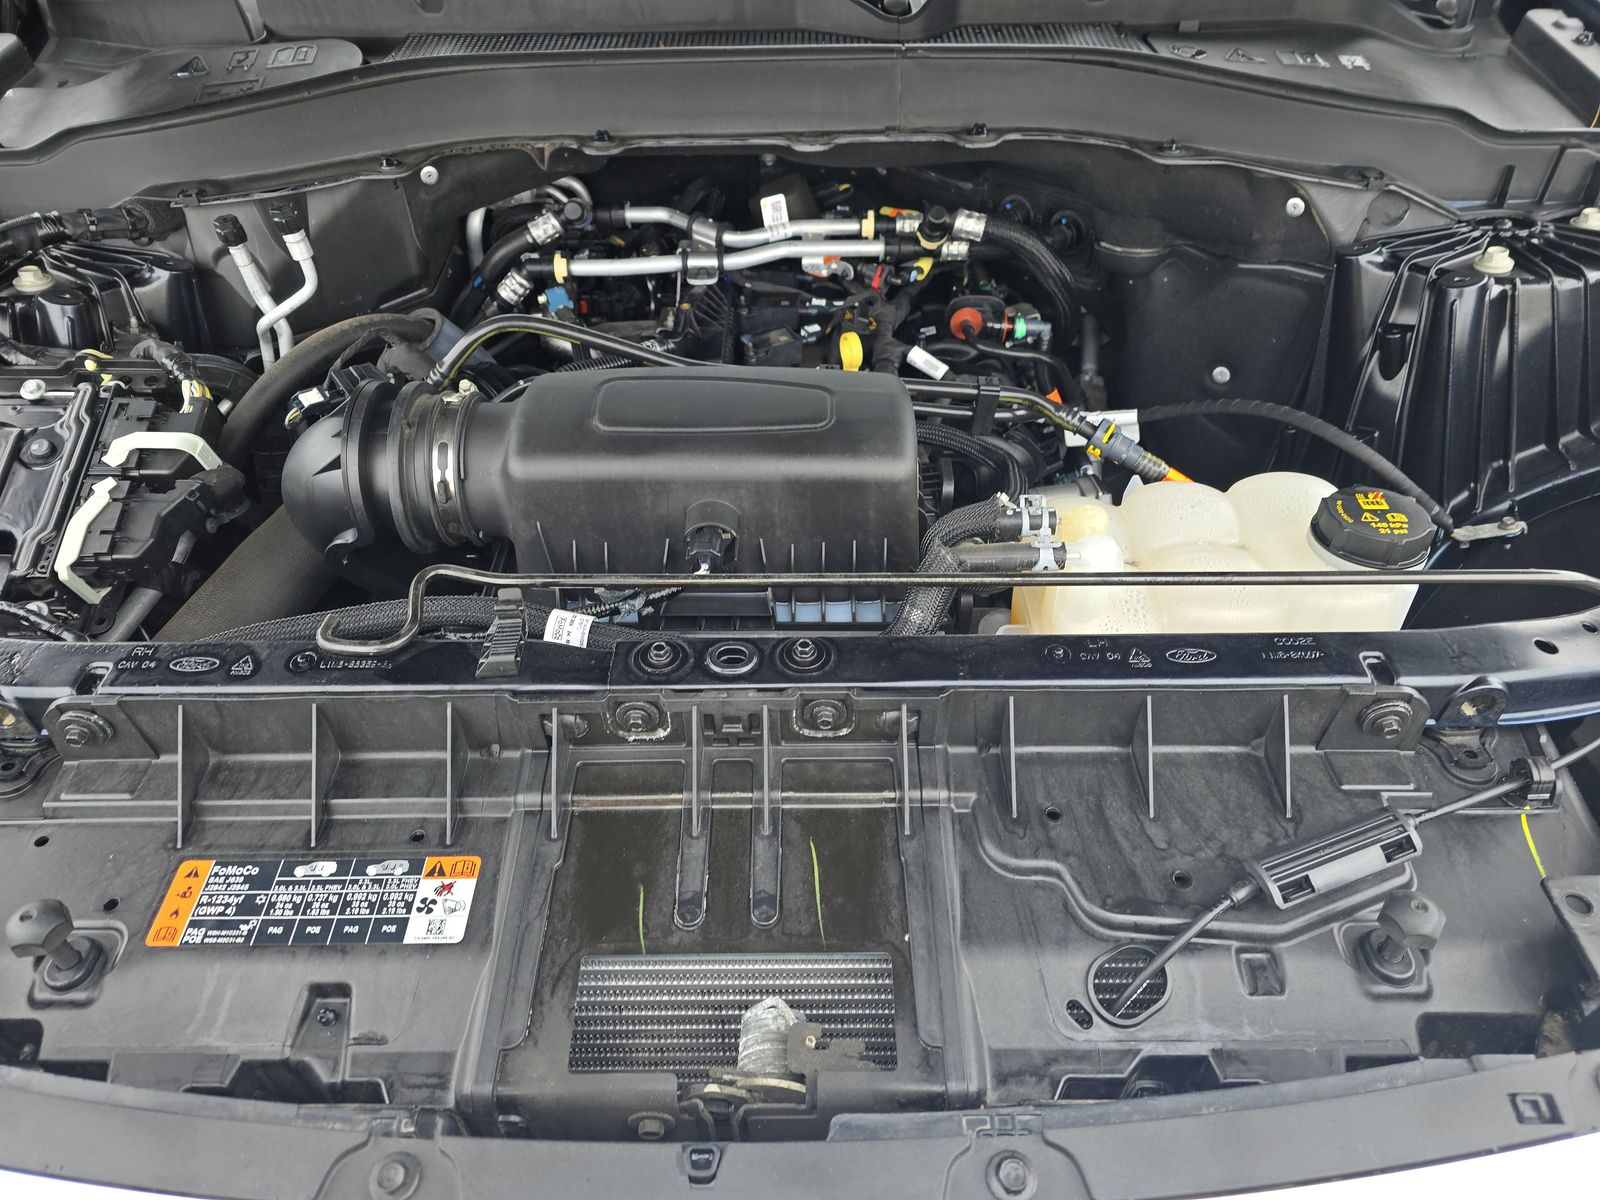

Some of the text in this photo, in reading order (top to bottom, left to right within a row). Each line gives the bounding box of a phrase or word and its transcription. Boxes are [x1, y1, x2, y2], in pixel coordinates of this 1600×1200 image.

[131, 646, 155, 656] RH
[1170, 648, 1213, 663] Ford
[118, 660, 157, 669] CAV 04
[172, 657, 217, 671] Ford
[211, 865, 260, 876] FoMoCo
[199, 895, 246, 905] R-1234yf
[292, 894, 303, 904] kg
[307, 894, 339, 903] 0.737 kg
[368, 892, 378, 903] kg
[404, 892, 414, 903] kg
[194, 906, 236, 916] (GWP 4)
[185, 928, 206, 936] PAG
[305, 926, 322, 934] POE
[381, 925, 397, 933] POE
[182, 935, 204, 944] POE
